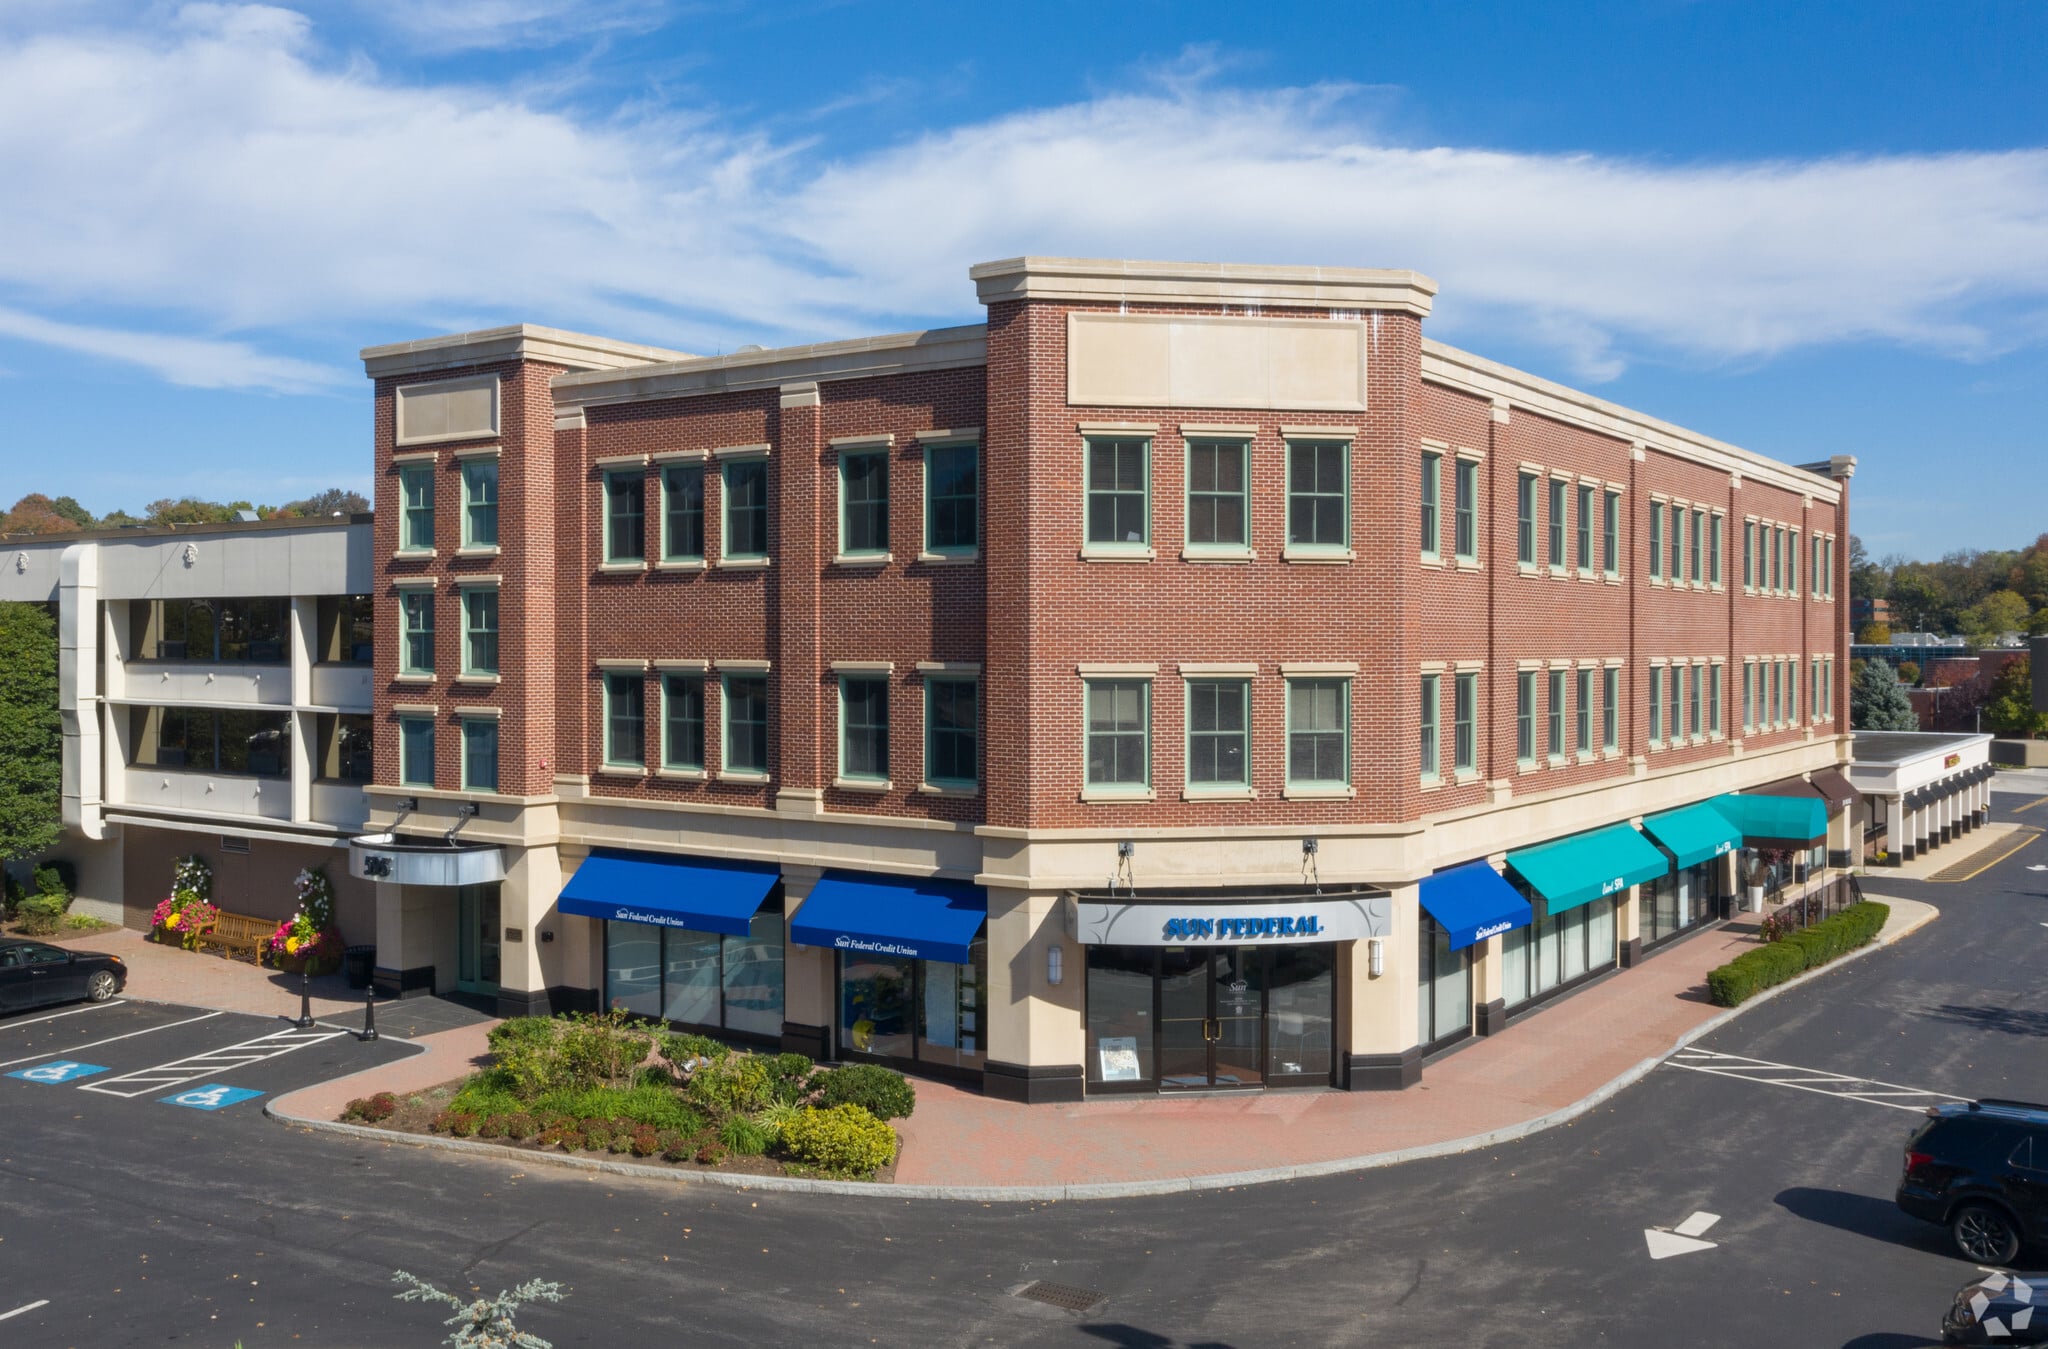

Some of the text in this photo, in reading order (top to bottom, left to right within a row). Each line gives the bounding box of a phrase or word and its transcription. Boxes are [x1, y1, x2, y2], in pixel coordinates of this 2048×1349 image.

[616, 908, 684, 926] Sun Federal Credit Union
[1168, 915, 1320, 936] SUN FEDERAL
[835, 936, 918, 956] Sun Federal Credit Union
[1229, 982, 1247, 992] Sun
